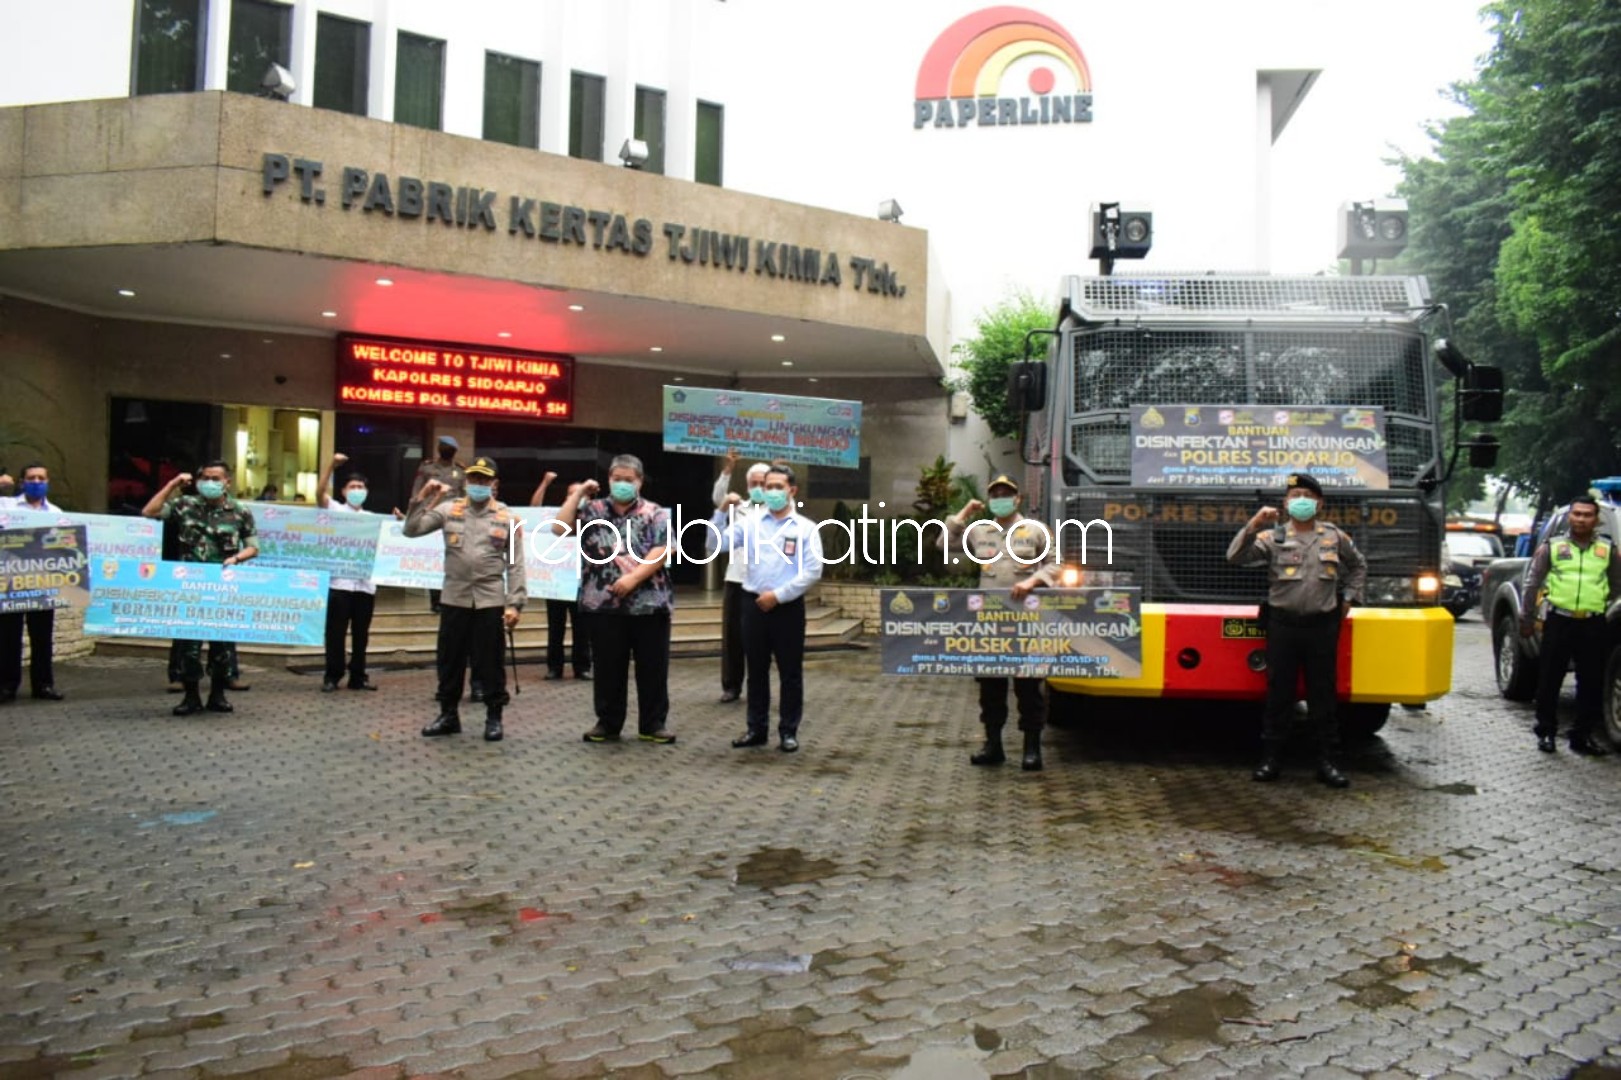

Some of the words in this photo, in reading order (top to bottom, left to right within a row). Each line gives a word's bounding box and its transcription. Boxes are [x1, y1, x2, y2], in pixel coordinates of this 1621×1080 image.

[914, 94, 1093, 129] PAPERLINE
[263, 153, 325, 206] PT.
[343, 166, 497, 231] PABRIK
[508, 196, 653, 257] KERTAS
[663, 222, 749, 273] TJIWI
[754, 239, 842, 287] KIMIA
[353, 344, 437, 365] WELCOME
[443, 354, 464, 367] TO
[470, 356, 512, 373] TJIWI
[516, 360, 560, 377] KIMIA
[373, 368, 462, 388] KAPOLRES
[467, 376, 546, 394] SIDOARJO
[342, 386, 414, 403] KOMBES
[420, 392, 450, 406] POL
[456, 395, 542, 416] SUMARDJI,
[546, 402, 567, 415] SH
[769, 421, 856, 437] LINGKUNGAN
[1228, 426, 1289, 435] BANTUAN
[793, 434, 850, 450] BENDO
[1136, 436, 1248, 448] DISINFEKTAN
[1268, 437, 1382, 449] LINGKUNGAN
[1181, 451, 1251, 465] POLRES
[1257, 451, 1355, 466] SIDOARJO
[1169, 475, 1183, 484] PT
[1187, 475, 1225, 484] Pabrik
[1229, 475, 1266, 485] Kertas
[12, 572, 81, 590] BENDO
[182, 581, 239, 593] BANTUAN
[977, 611, 1039, 621] BANTUAN
[886, 622, 997, 635] DISINFEKTAN
[1018, 622, 1134, 636] LINGKUNGAN
[945, 638, 1013, 653] POLSEK
[1016, 638, 1072, 653] TARIK
[918, 664, 932, 673] PT
[936, 664, 974, 673] Pabrik
[978, 664, 1015, 674] Kertas
